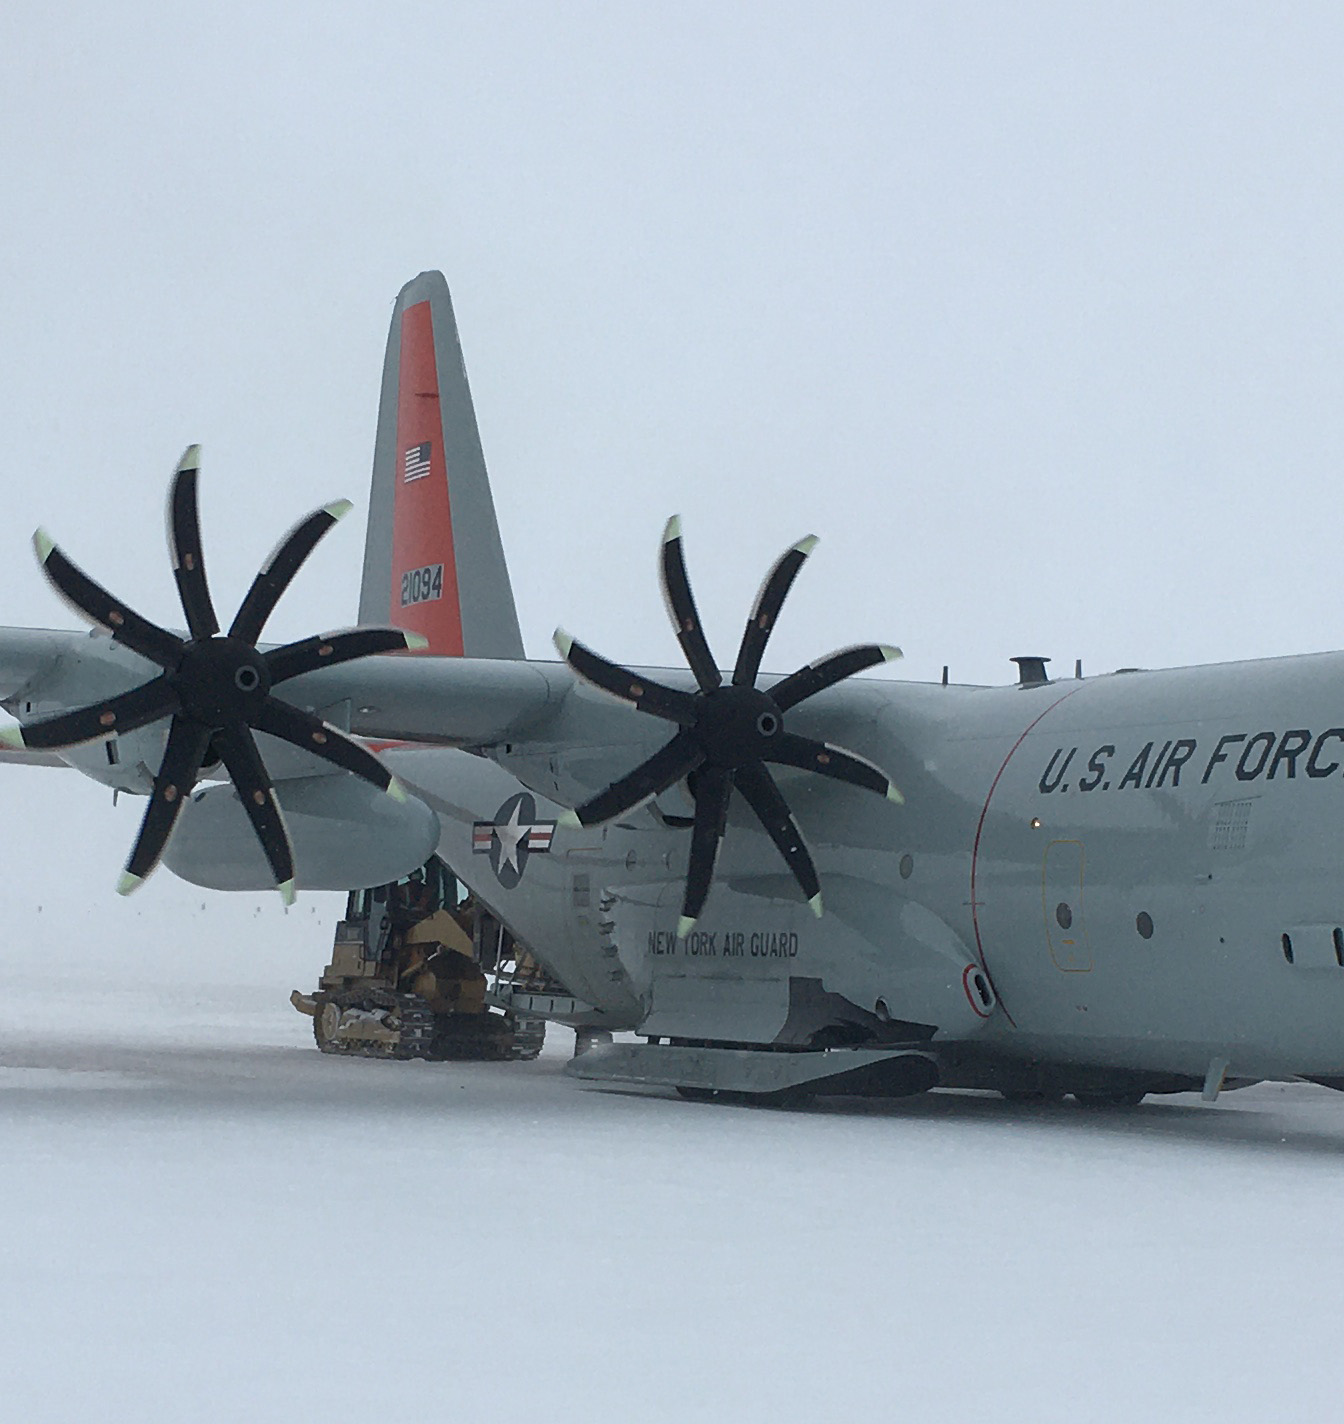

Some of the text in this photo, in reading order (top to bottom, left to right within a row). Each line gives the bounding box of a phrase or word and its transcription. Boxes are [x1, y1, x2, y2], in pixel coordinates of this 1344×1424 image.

[401, 565, 443, 606] 21094
[1038, 744, 1116, 794] U.S.
[1118, 738, 1197, 790] AIR
[648, 931, 677, 955] NEW
[723, 932, 745, 957] AIR
[750, 932, 799, 958] GUARD
